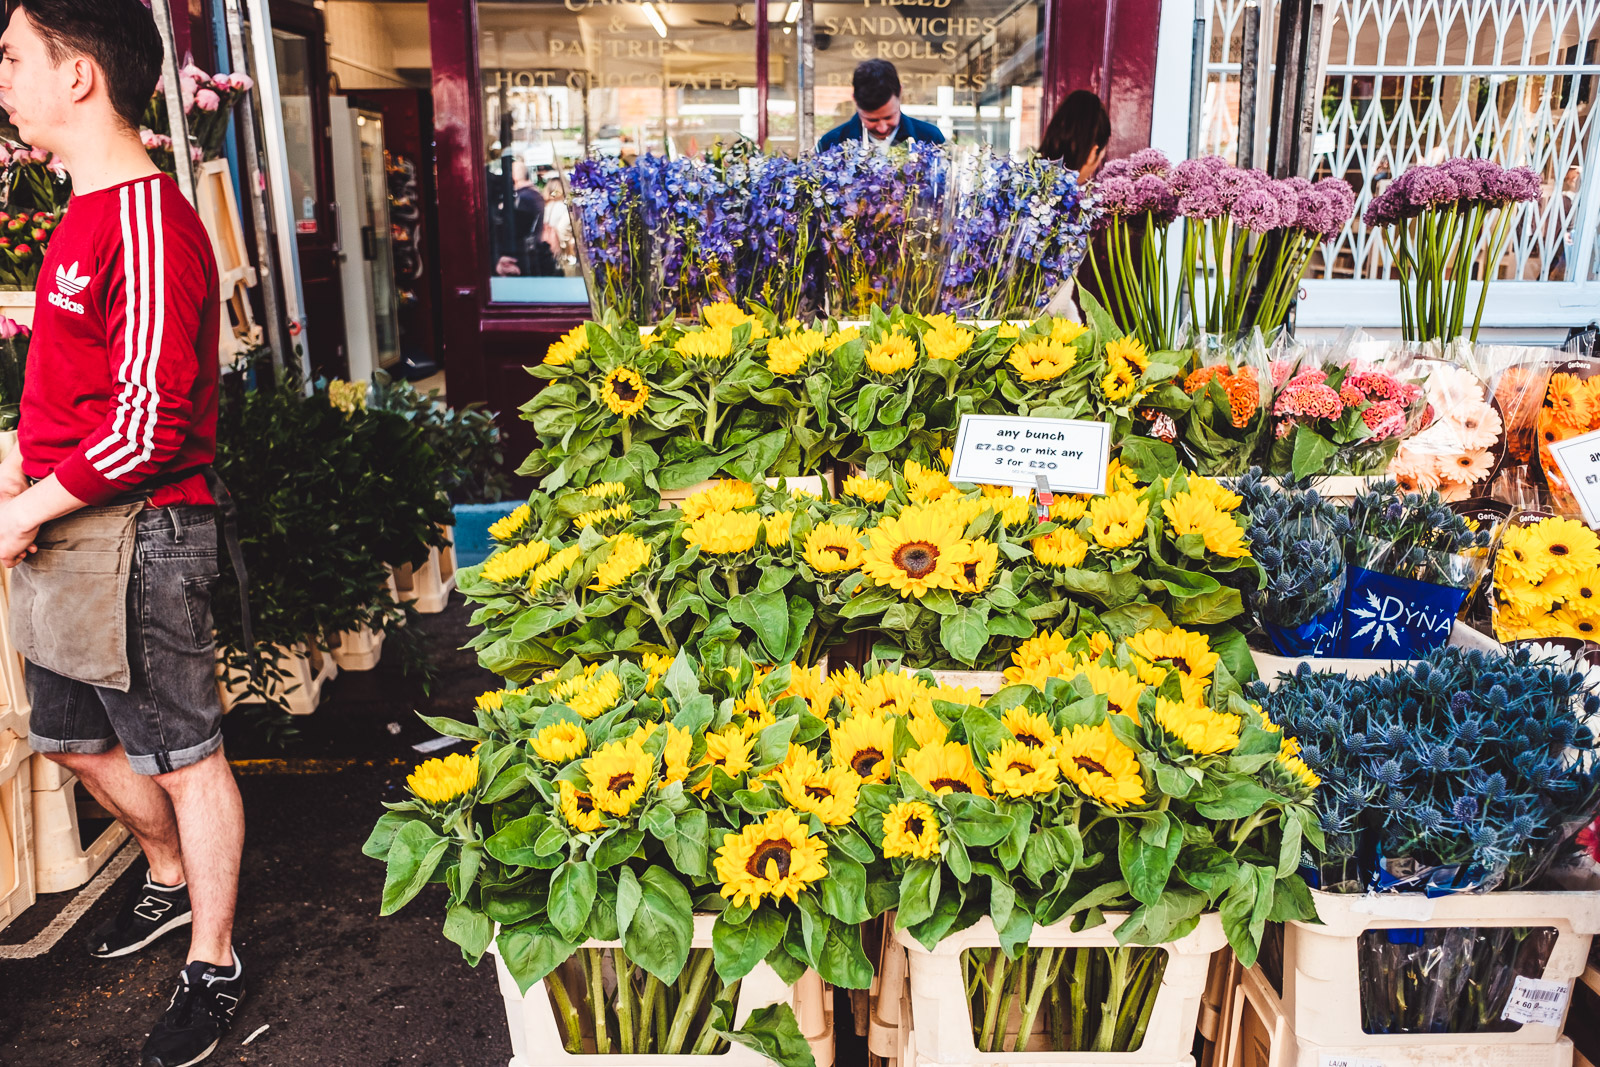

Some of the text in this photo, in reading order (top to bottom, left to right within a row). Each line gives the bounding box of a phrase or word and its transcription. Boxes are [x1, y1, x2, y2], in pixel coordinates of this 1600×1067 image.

[608, 15, 628, 34] &
[824, 16, 997, 37] SANDWICHES
[549, 39, 694, 58] PASTRIES
[852, 40, 958, 60] & ROLLS
[495, 71, 738, 90] HOT CHOCOLATE
[827, 72, 988, 93] BAETTES
[48, 291, 85, 315] adidas
[1567, 361, 1591, 370] Gerbera
[996, 429, 1065, 441] any bunch
[975, 443, 1015, 452] £7.50
[1035, 446, 1057, 456] mix
[1061, 449, 1083, 460] any
[995, 457, 1058, 470] 3 for £20
[1380, 595, 1451, 636] DYNA
[133, 895, 173, 921] N
